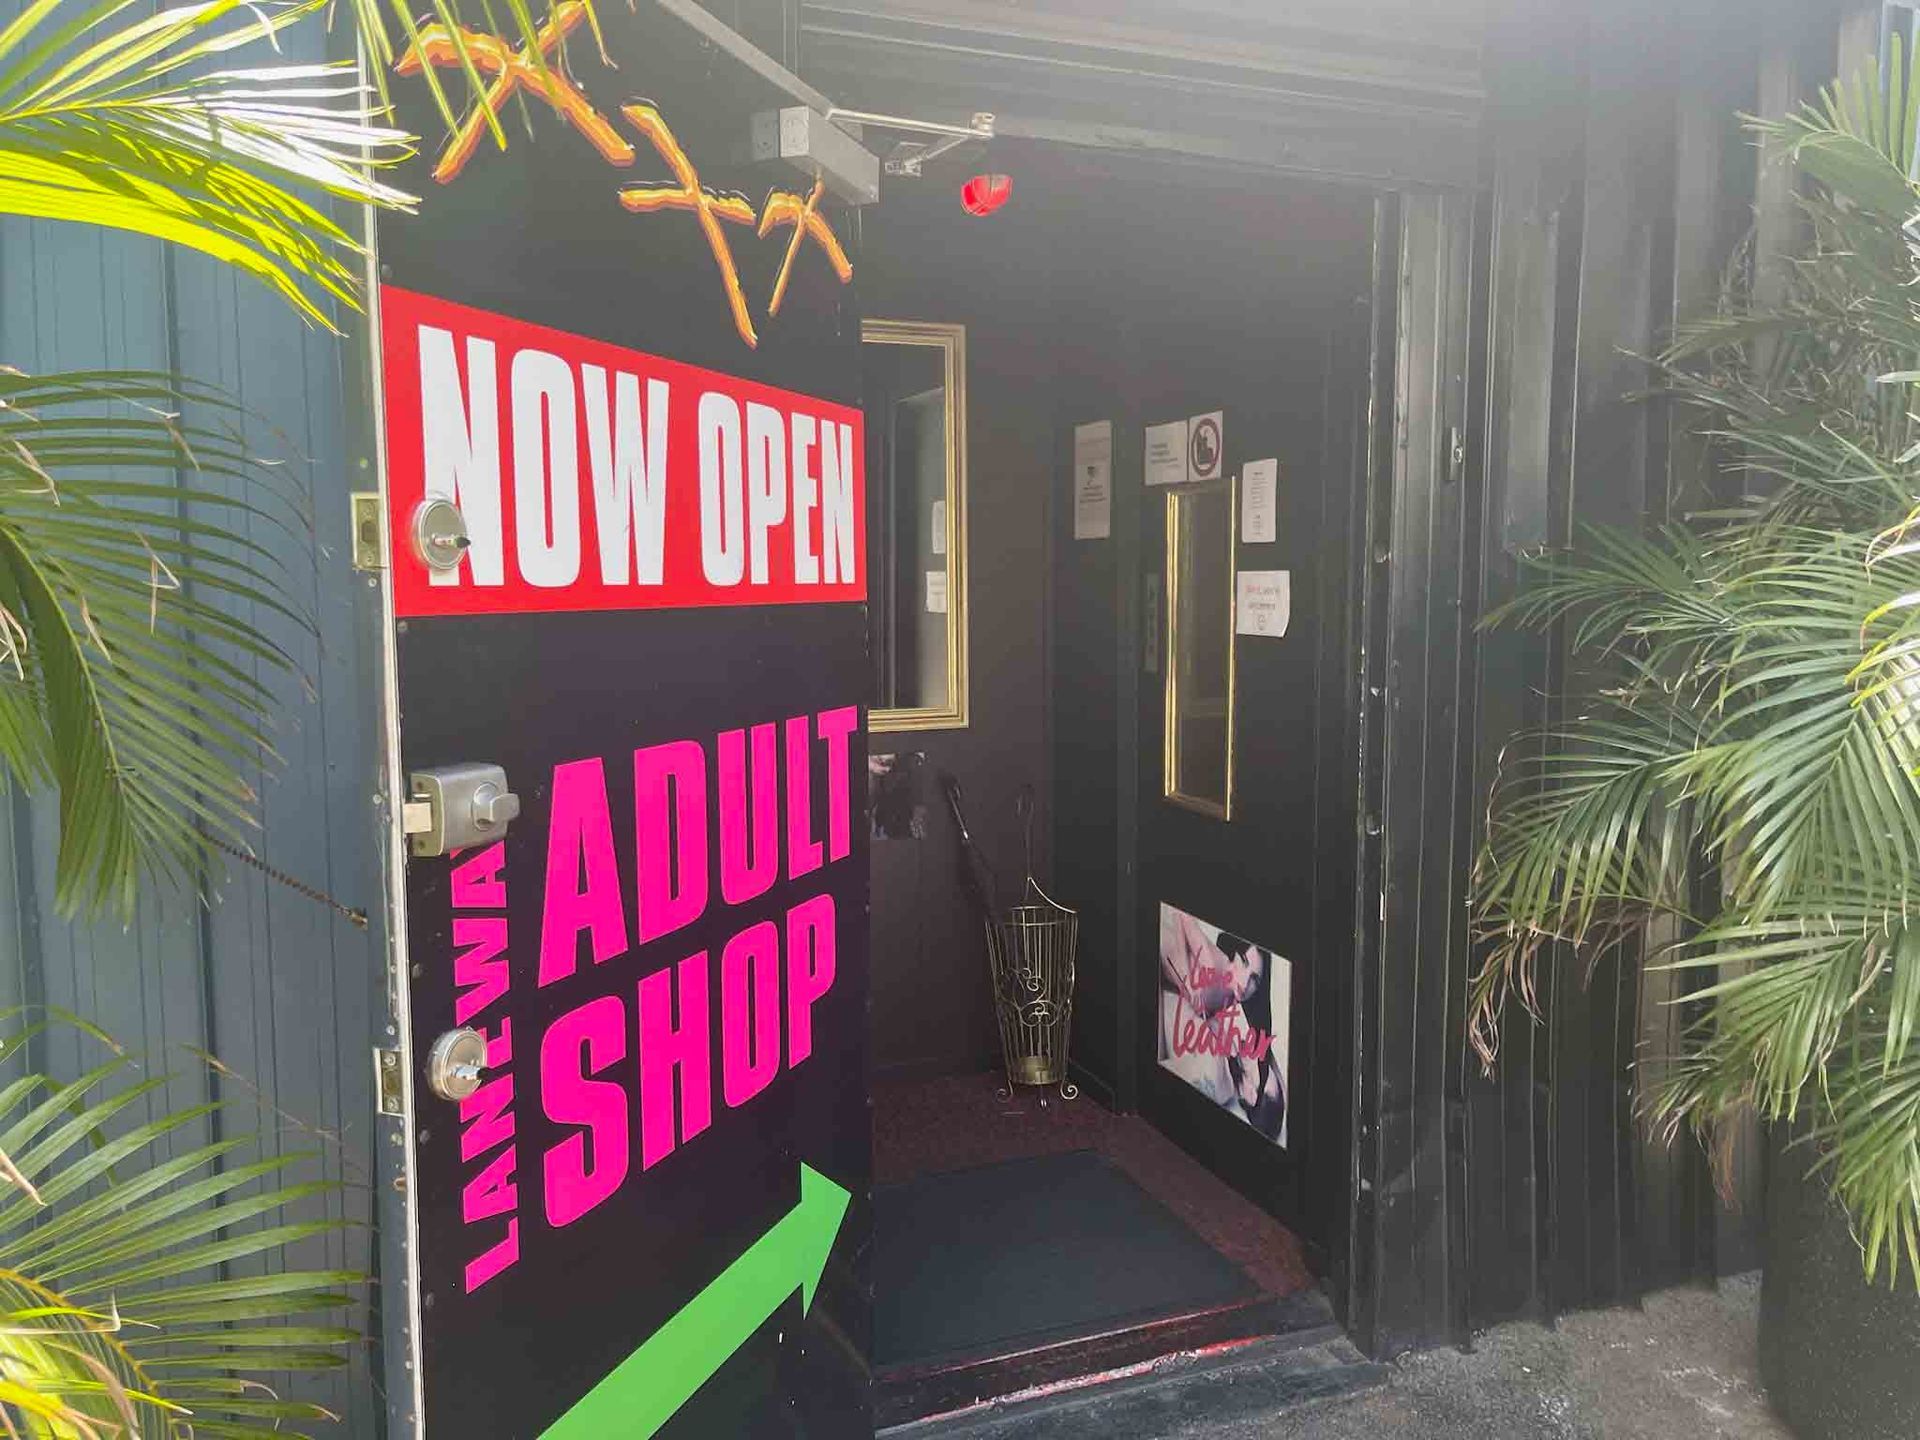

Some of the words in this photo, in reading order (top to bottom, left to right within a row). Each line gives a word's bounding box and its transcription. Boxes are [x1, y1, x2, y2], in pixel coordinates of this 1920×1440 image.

[418, 323, 670, 587] NOW
[699, 391, 855, 586] OPEN
[539, 705, 858, 988] ADULT
[450, 838, 520, 1294] LANEWA
[539, 894, 836, 1228] SHOP
